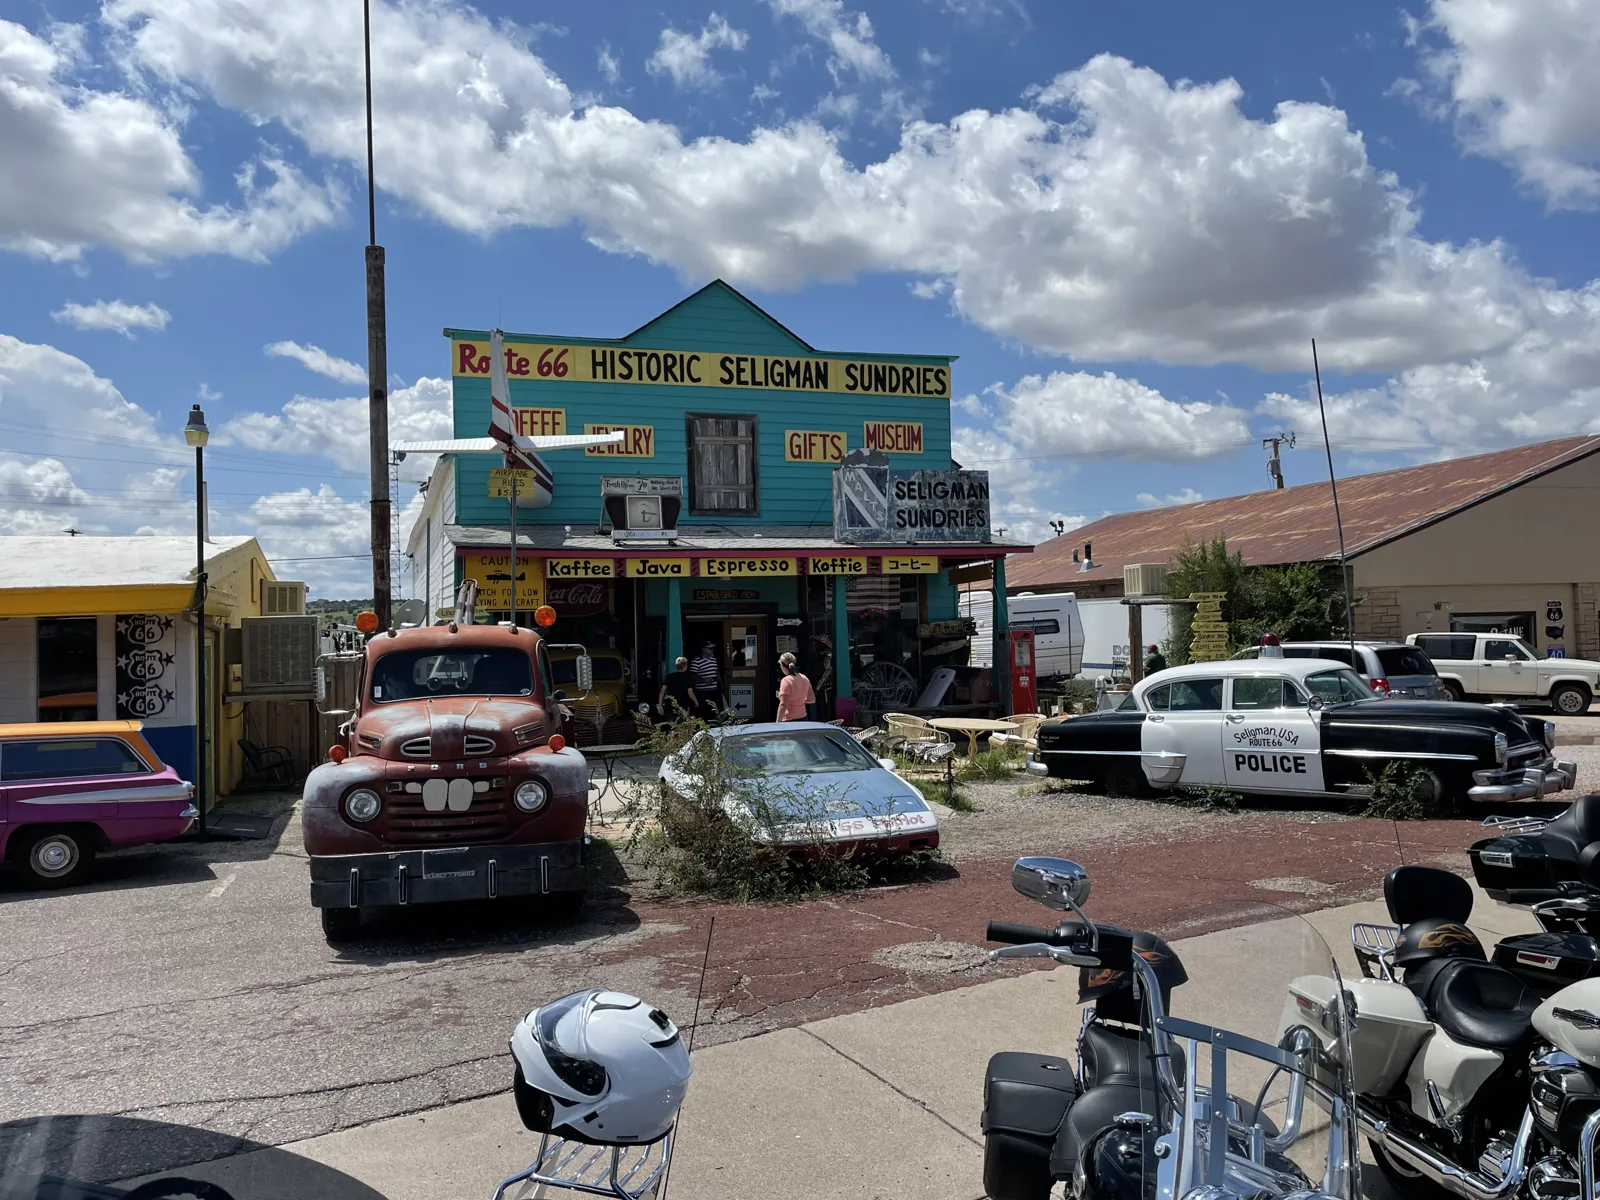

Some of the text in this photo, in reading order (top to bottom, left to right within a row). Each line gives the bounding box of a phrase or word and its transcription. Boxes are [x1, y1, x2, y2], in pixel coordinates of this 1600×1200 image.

[459, 344, 947, 395] Rote 66 HISTORIC SELIGMAN SUNDRIES
[513, 410, 562, 437] OFFEE
[865, 424, 922, 451] MUSEUM
[789, 432, 843, 460] GIFTS
[495, 470, 528, 478] AIRPLANE
[845, 471, 884, 521] MALTS
[895, 481, 989, 500] SELIGMAN
[896, 509, 986, 528] SUNDRIES
[480, 556, 529, 566] CAUTON
[549, 560, 611, 576] Kaffee
[636, 559, 682, 575] Java
[706, 559, 790, 575] Espresso
[812, 558, 863, 573] Koffie
[888, 558, 931, 571] コーヒー
[479, 588, 538, 597] ATCH FO LOW
[696, 590, 738, 600] ESTABLISHED
[476, 598, 540, 607] LYING AICRAFT
[1550, 611, 1560, 619] 66
[135, 627, 155, 640] 66
[1550, 650, 1563, 658] 40
[136, 663, 156, 676] 66
[135, 699, 156, 712] 66
[1249, 738, 1283, 747] ROUTE 66
[1278, 727, 1299, 746] USA
[407, 763, 488, 772] FORD
[1234, 754, 1307, 774] POLICE
